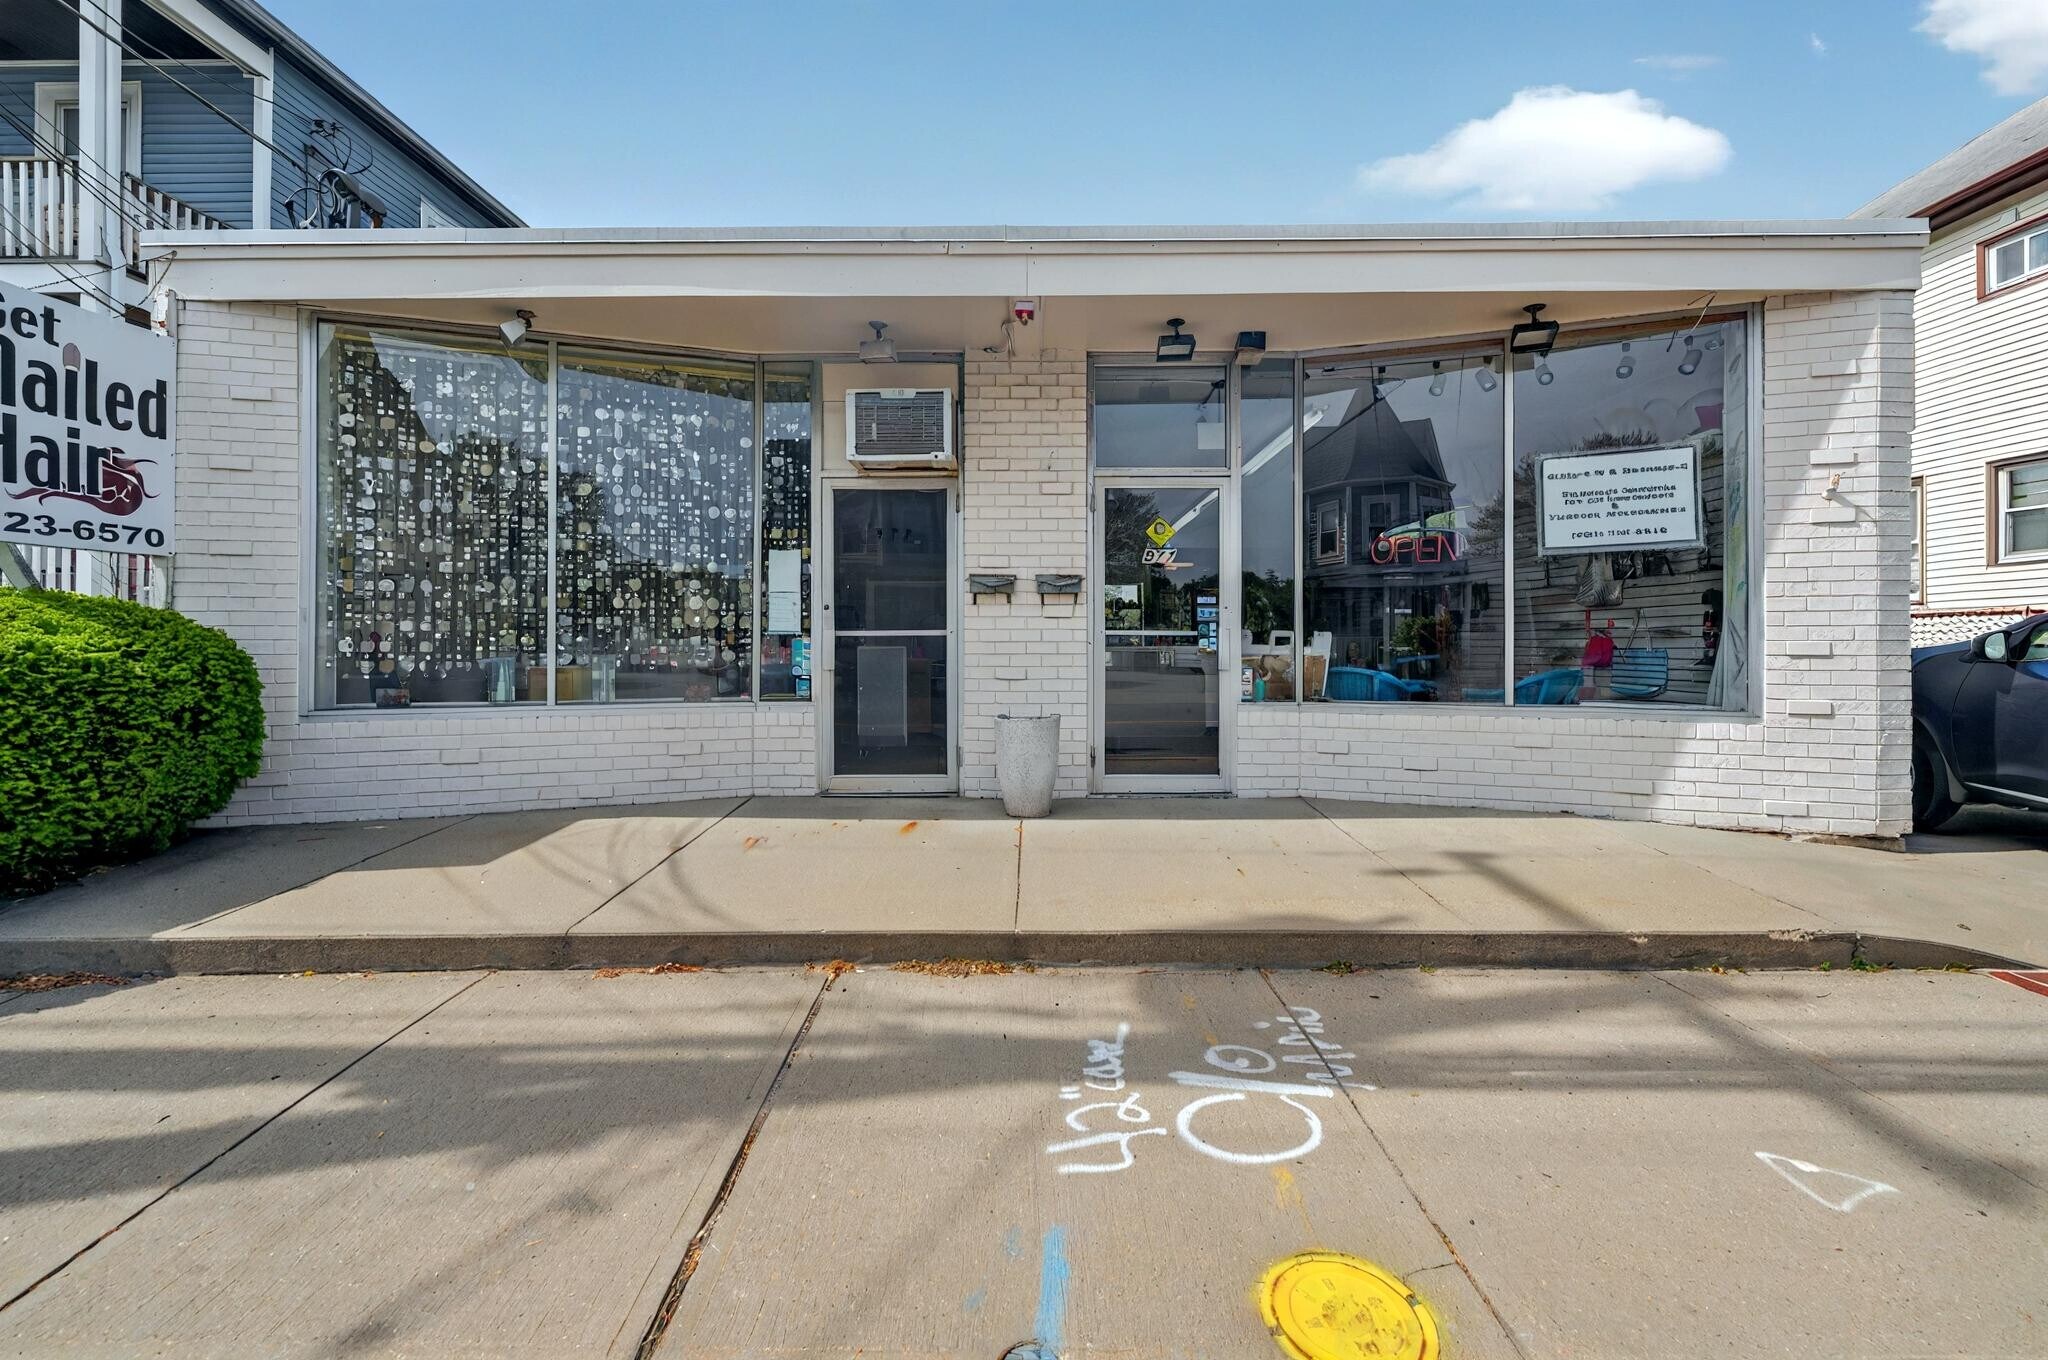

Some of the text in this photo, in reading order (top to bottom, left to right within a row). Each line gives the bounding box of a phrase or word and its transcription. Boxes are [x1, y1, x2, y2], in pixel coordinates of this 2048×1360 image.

[0, 291, 61, 347] et
[3, 511, 165, 548] 23-6570
[1371, 535, 1460, 563] OPEN
